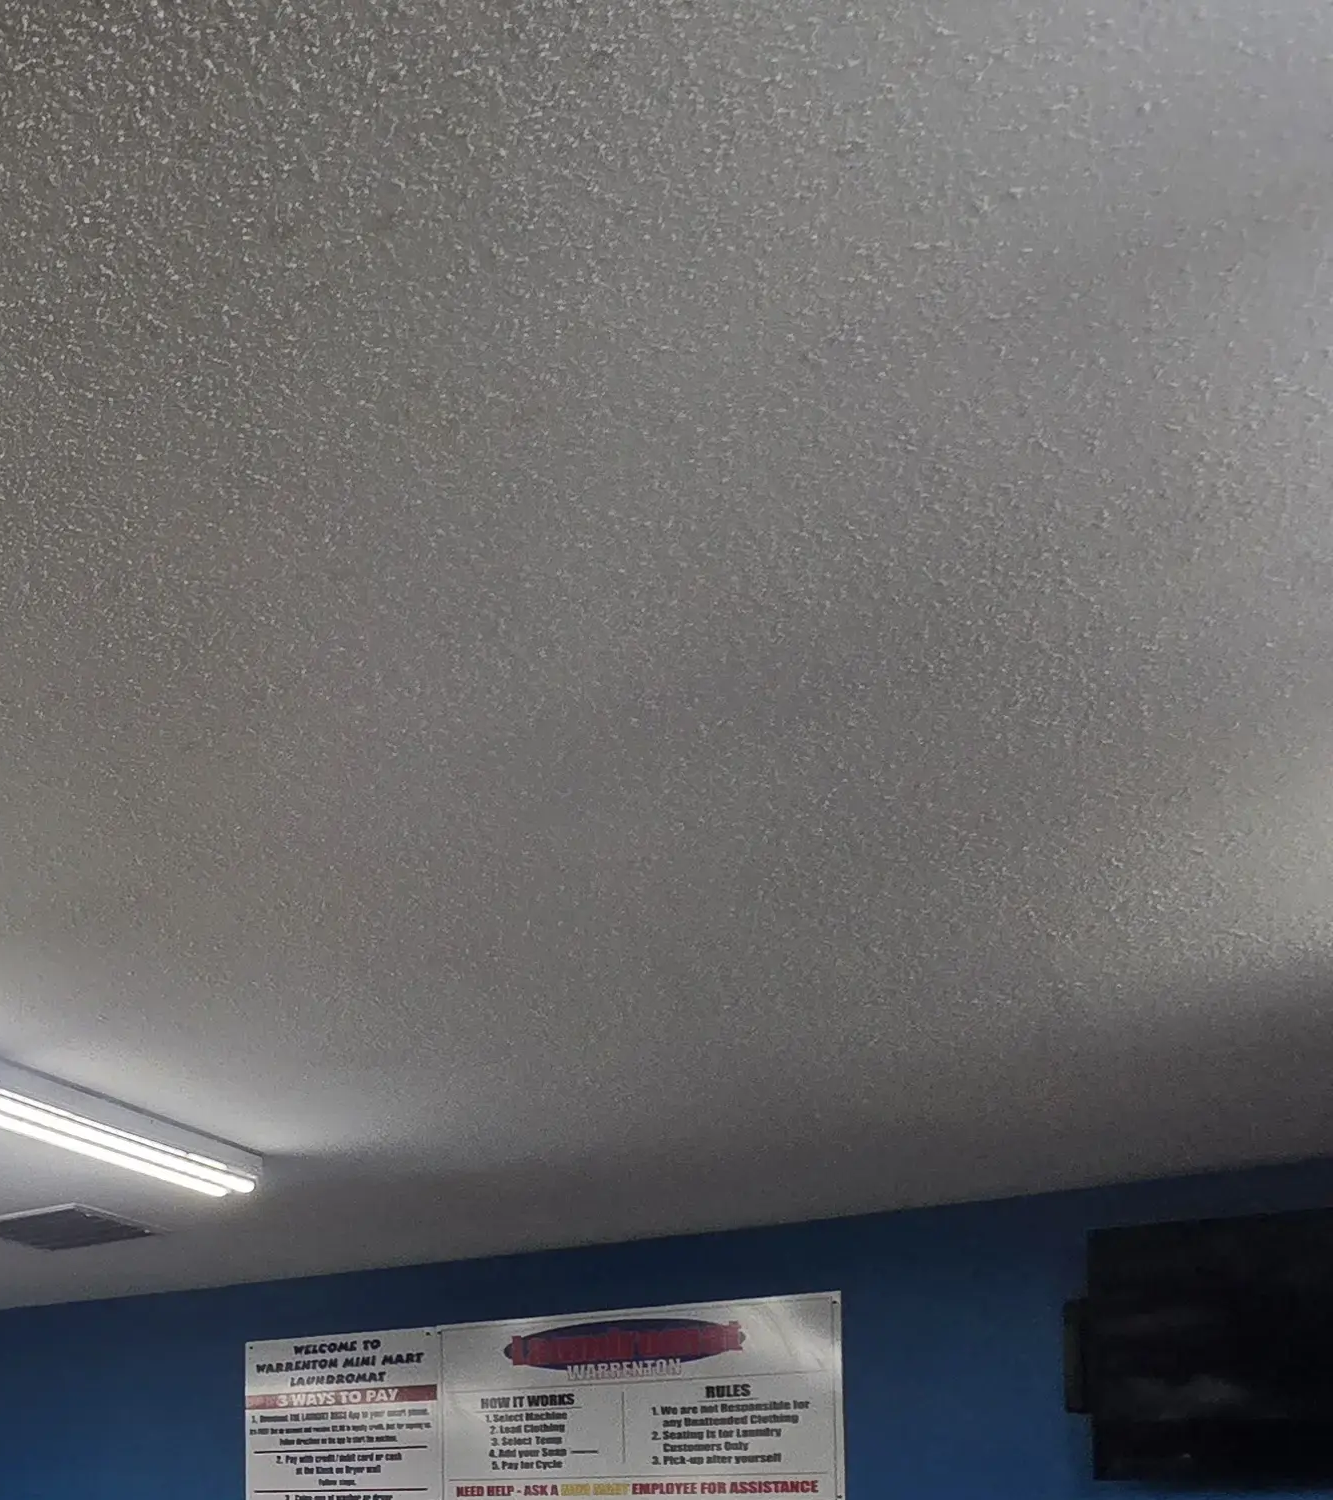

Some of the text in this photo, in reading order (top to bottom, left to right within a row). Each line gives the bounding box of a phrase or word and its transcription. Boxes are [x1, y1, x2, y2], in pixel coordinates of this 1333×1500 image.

[293, 1339, 382, 1356] WELCOME TO
[256, 1352, 425, 1374] WARRENTON MINI MART
[566, 1358, 682, 1381] WARRENTON
[289, 1371, 386, 1387] LAUNDROMAT
[278, 1388, 399, 1408] 3 WAYS TO PAY
[705, 1384, 751, 1398] RULES
[481, 1393, 575, 1409] HOW IT WORKS
[660, 1406, 678, 1415] We
[680, 1406, 698, 1414] are
[700, 1404, 719, 1414] not
[721, 1401, 791, 1413] Responsible
[793, 1400, 810, 1410] for
[493, 1413, 523, 1423] Select
[525, 1412, 567, 1421] Machine
[662, 1413, 799, 1428] any Unattended Clothing
[499, 1425, 522, 1434] Load
[524, 1424, 565, 1433] Clothing
[651, 1427, 782, 1441] 2. Seating is for Laundry
[501, 1437, 532, 1446] Select
[663, 1441, 749, 1453] Customers Only
[498, 1449, 517, 1458] Add
[518, 1449, 540, 1458] your
[651, 1453, 782, 1465] 3. Pick-up after yourself
[501, 1461, 519, 1470] Pay
[520, 1460, 534, 1469] for
[535, 1460, 563, 1470] Cycle
[456, 1480, 819, 1497] NEED HELP ASK A EMPLOYEE FOR ASSISTANCE
